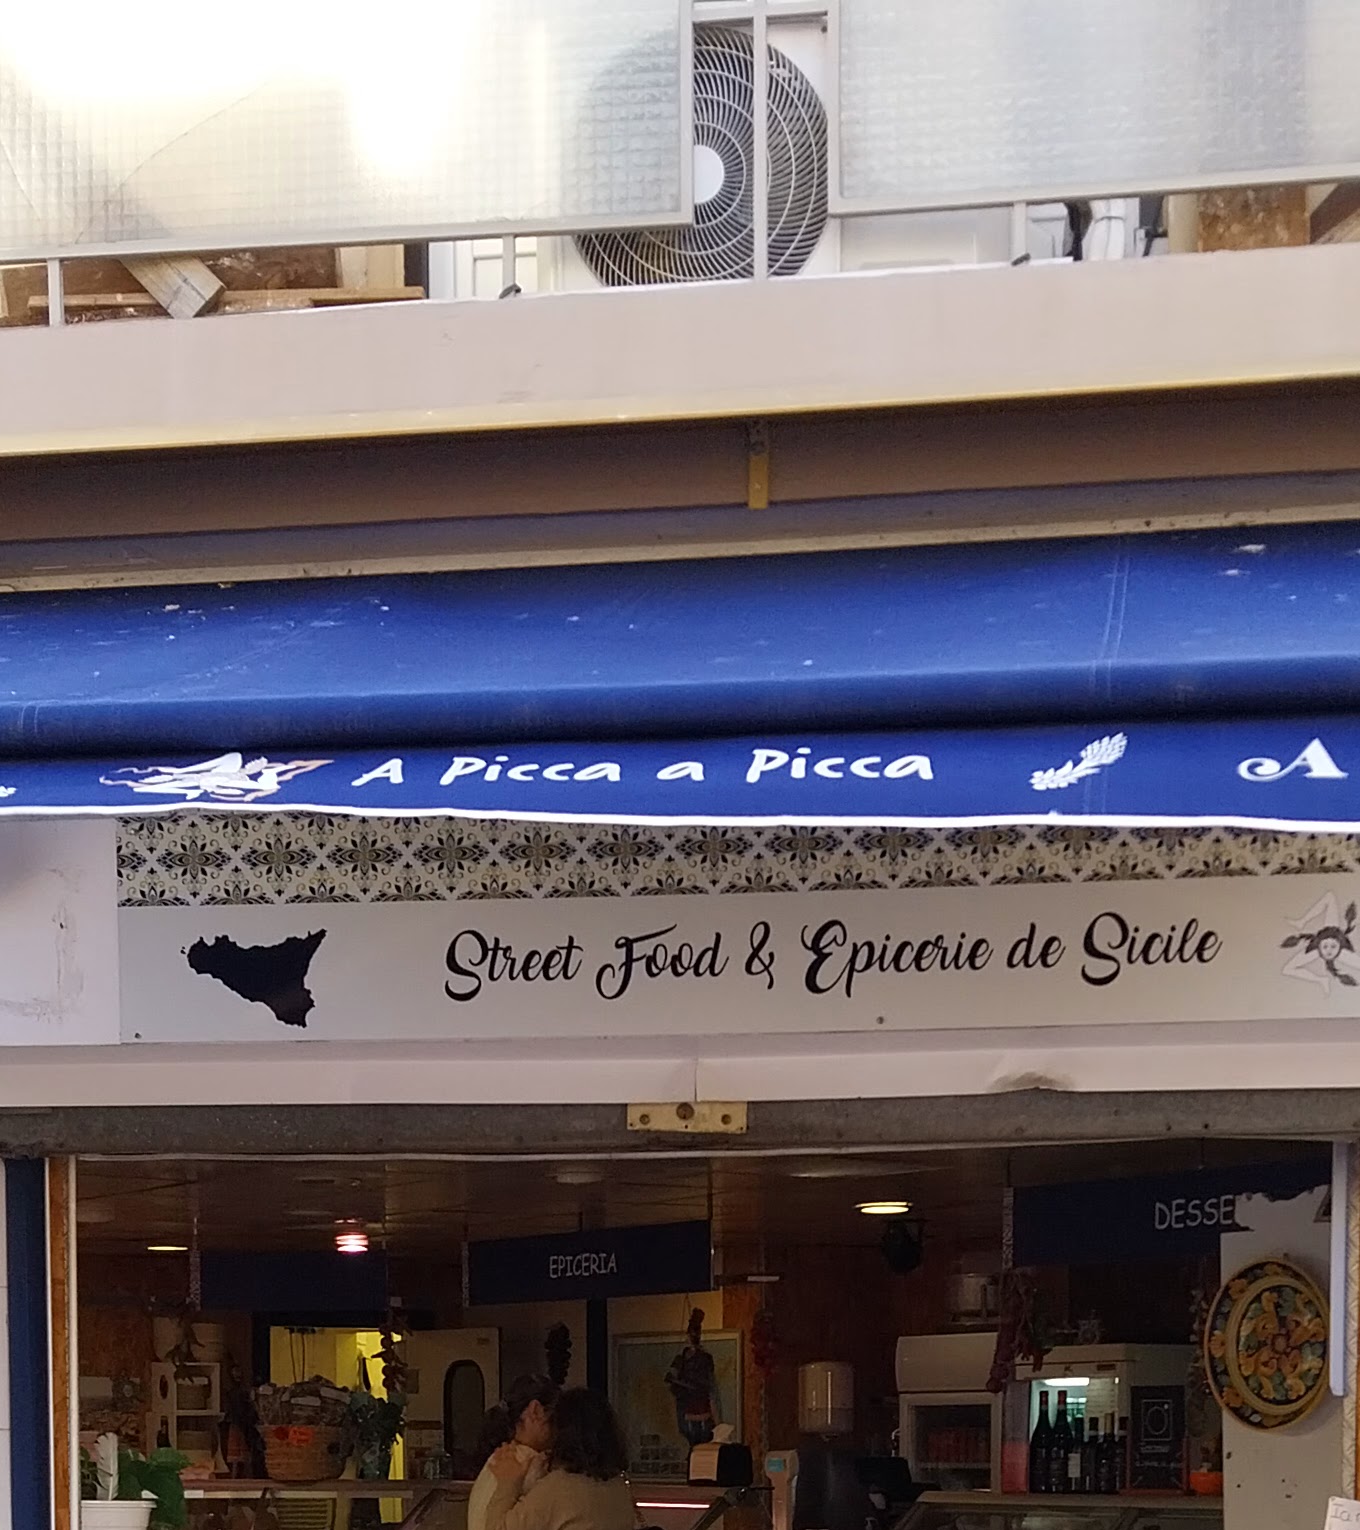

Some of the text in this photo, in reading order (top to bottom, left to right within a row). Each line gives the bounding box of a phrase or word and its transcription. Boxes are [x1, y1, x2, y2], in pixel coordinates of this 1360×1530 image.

[351, 747, 935, 788] A Picca a Picca
[1237, 736, 1349, 782] A
[444, 909, 1224, 1002] Street Food & Epicerie de Sicile
[1154, 1194, 1235, 1230] DESSE
[549, 1253, 617, 1278] EPICERIA
